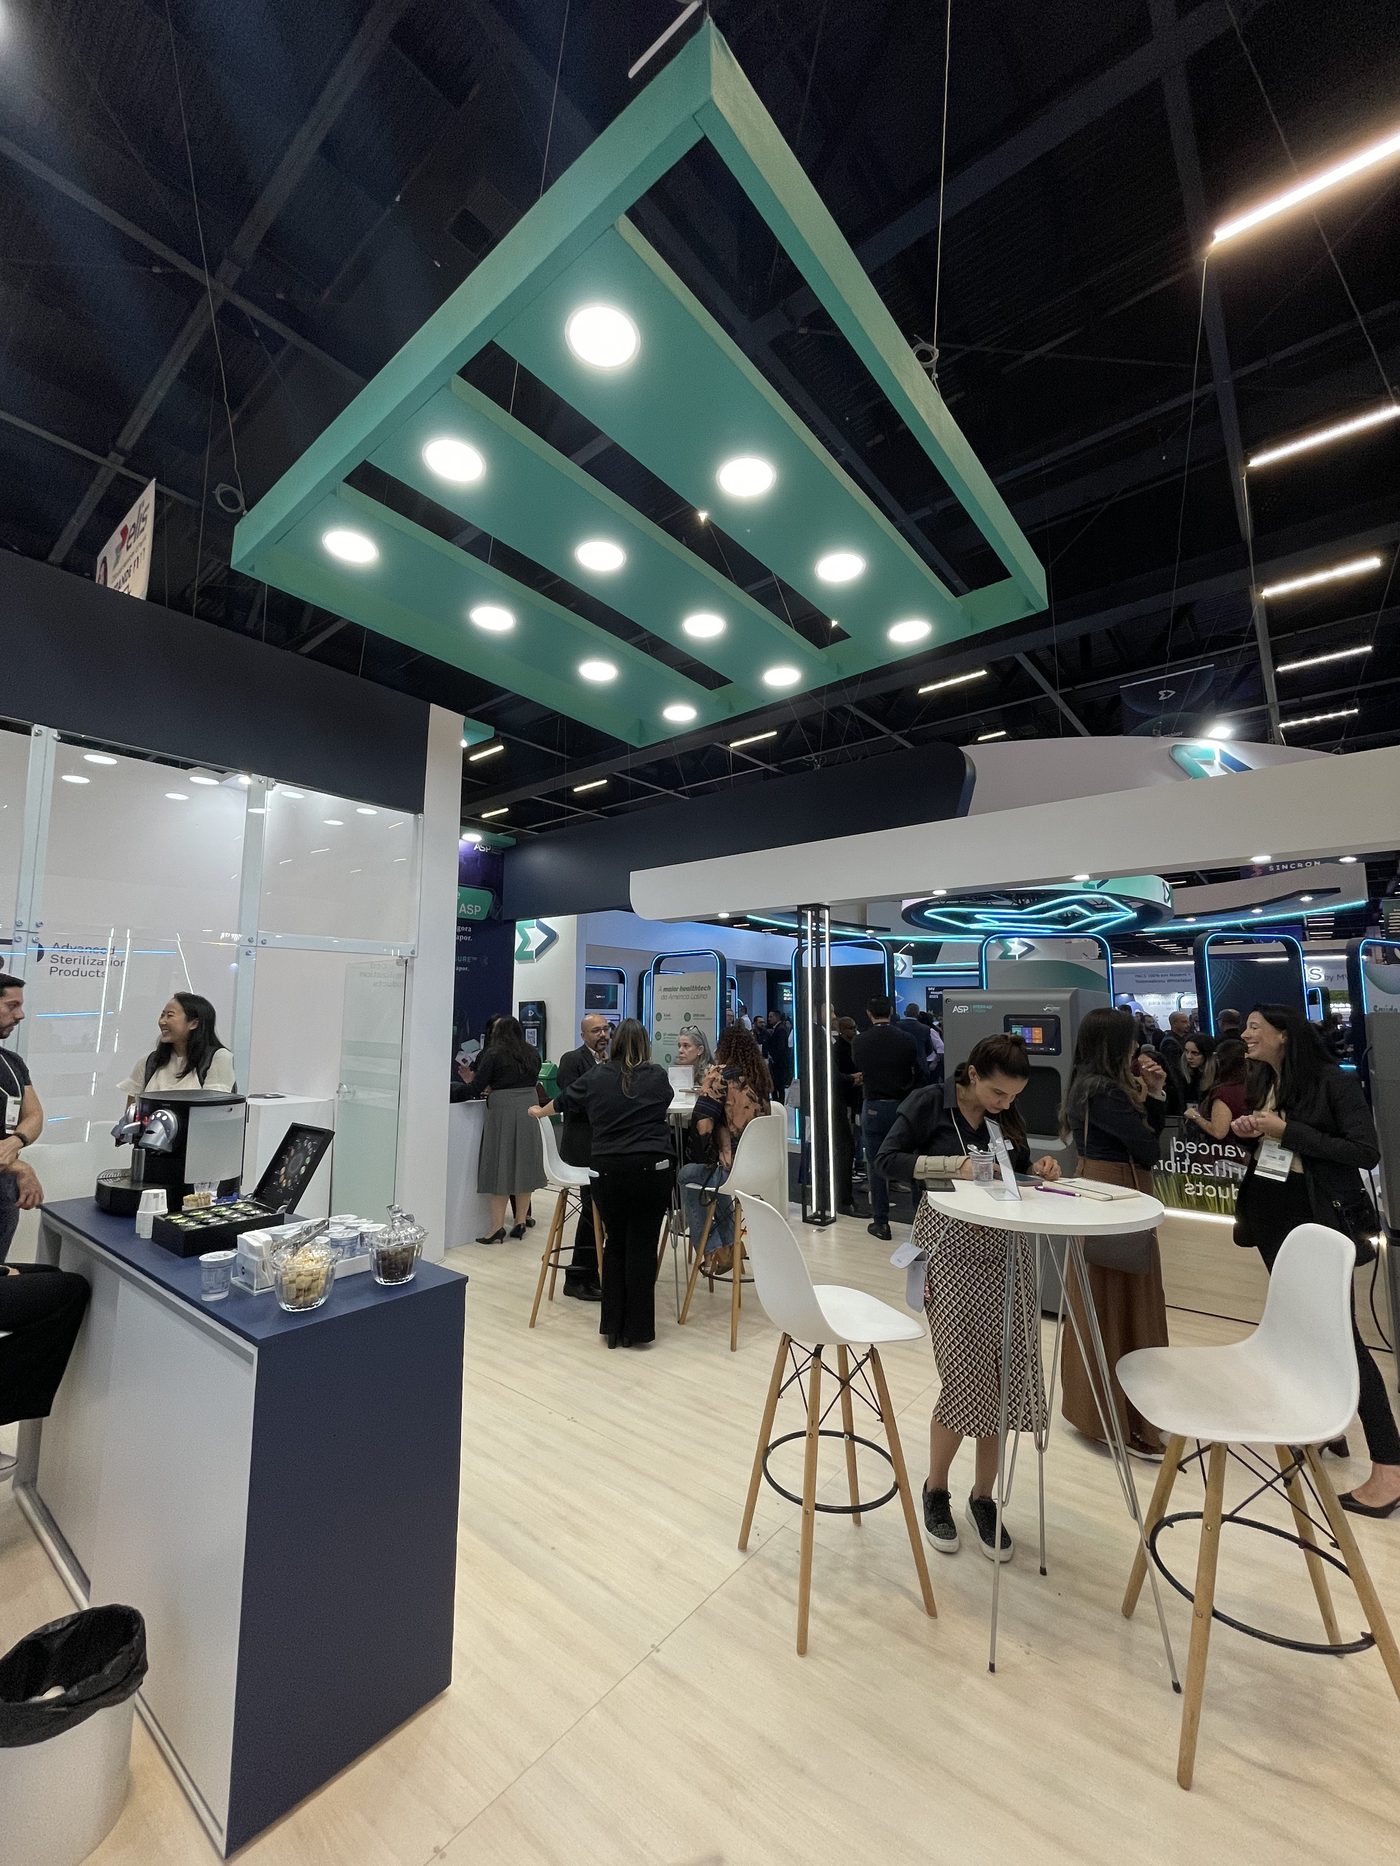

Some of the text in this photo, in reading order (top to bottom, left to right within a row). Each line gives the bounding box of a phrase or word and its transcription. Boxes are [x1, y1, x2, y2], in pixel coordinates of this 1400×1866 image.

[473, 843, 491, 852] ASP
[1269, 861, 1320, 872] SINCRON
[459, 903, 482, 915] ASP
[456, 925, 472, 933] gora
[456, 934, 473, 942] apor.
[49, 954, 127, 967] Sterilizaion
[49, 966, 107, 978] Products
[680, 983, 712, 992] healthtech
[952, 1005, 969, 1013] ASP
